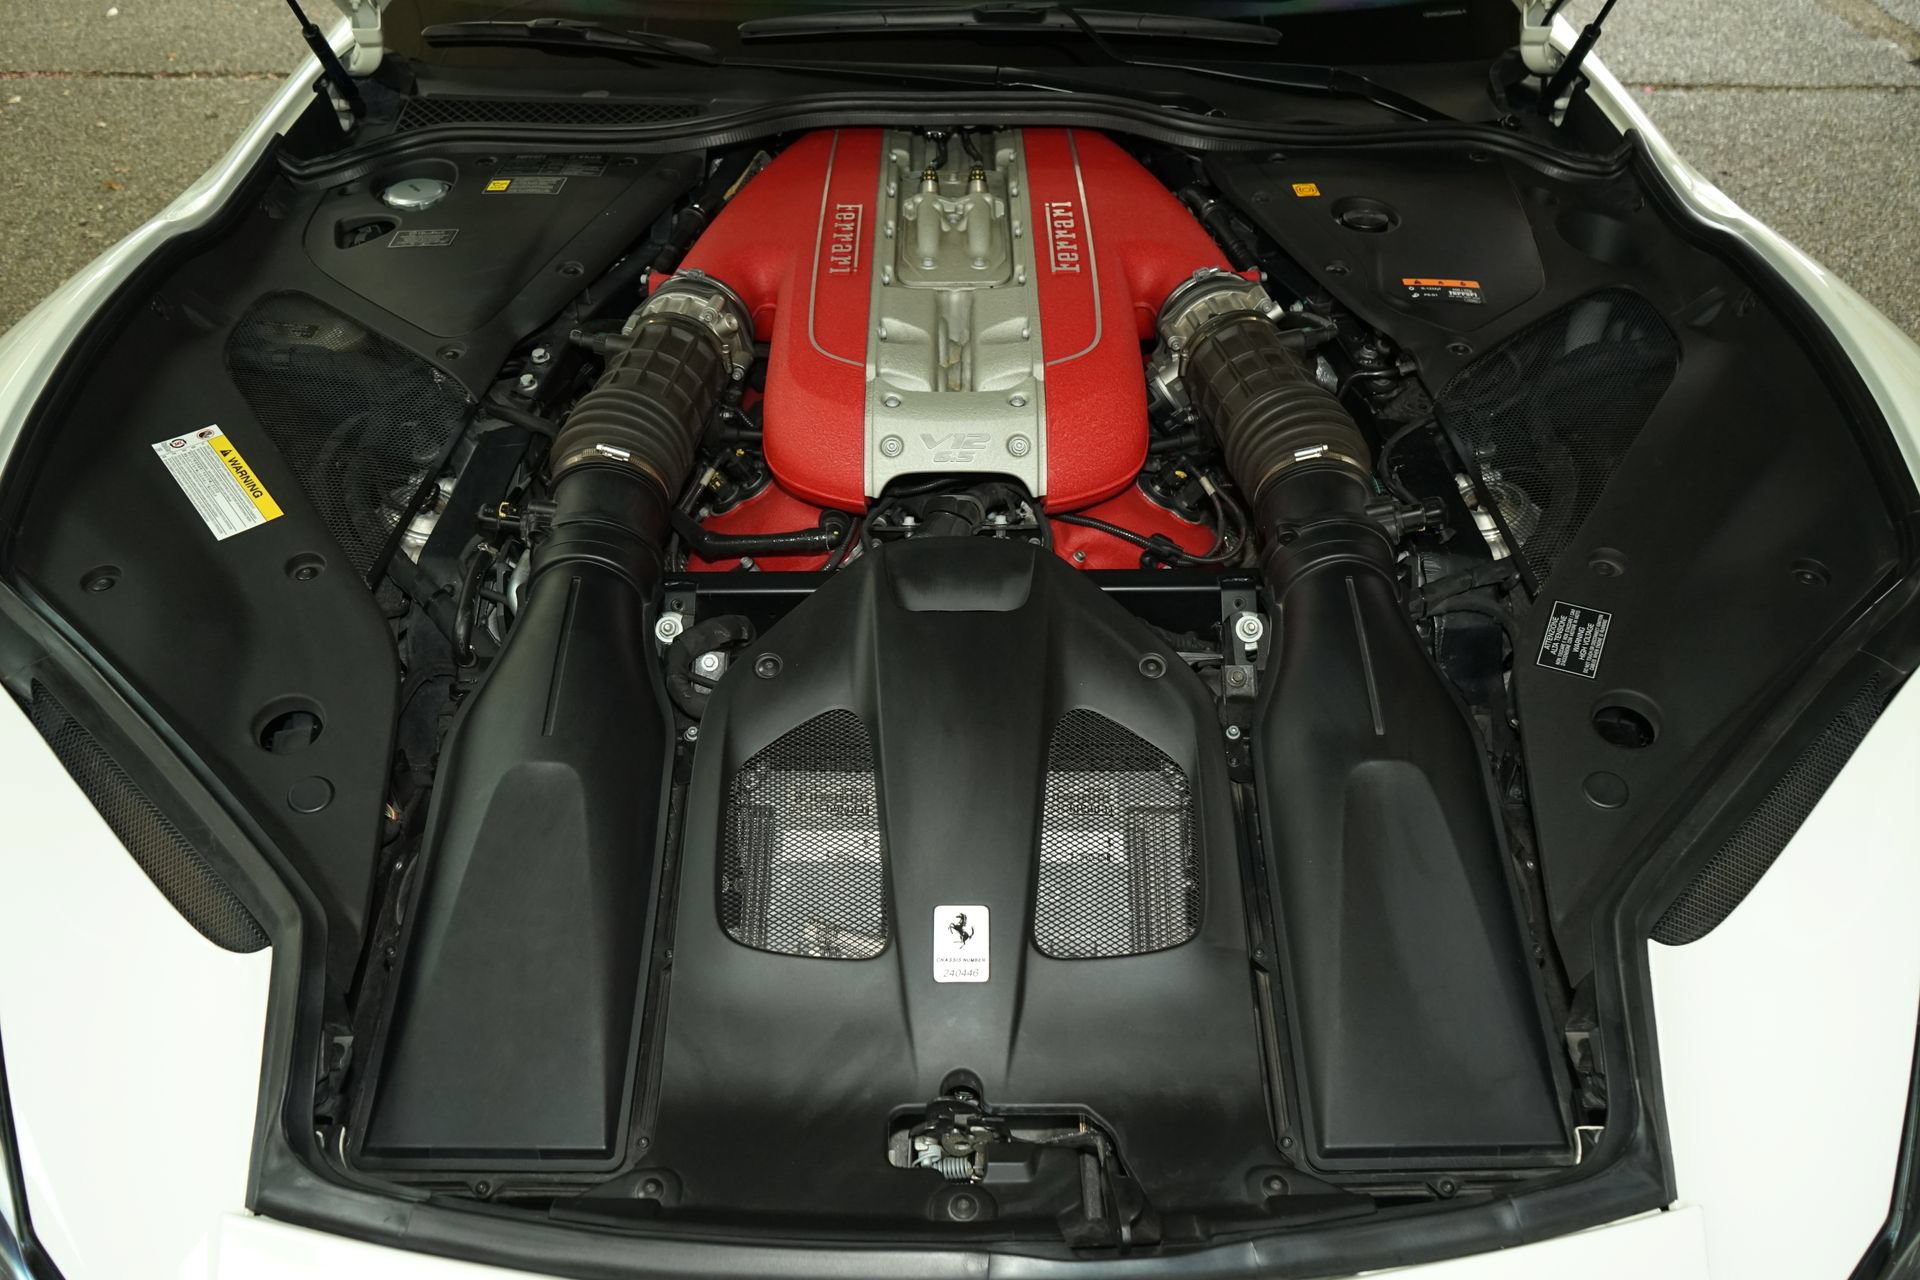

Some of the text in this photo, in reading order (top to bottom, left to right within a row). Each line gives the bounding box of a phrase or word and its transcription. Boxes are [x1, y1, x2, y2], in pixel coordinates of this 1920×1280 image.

[829, 203, 863, 274] Ferrari
[1044, 201, 1081, 273] Ferrari
[919, 433, 991, 450] V12
[933, 451, 976, 462] 6.5
[228, 457, 263, 499] WARNING
[1543, 616, 1559, 650] ATTENZIONE
[1550, 615, 1567, 655] ALTA TENSIONE
[1572, 626, 1585, 653] WARNING
[1578, 623, 1594, 660] HIGH VOLTAGE
[943, 968, 979, 978] 240446
